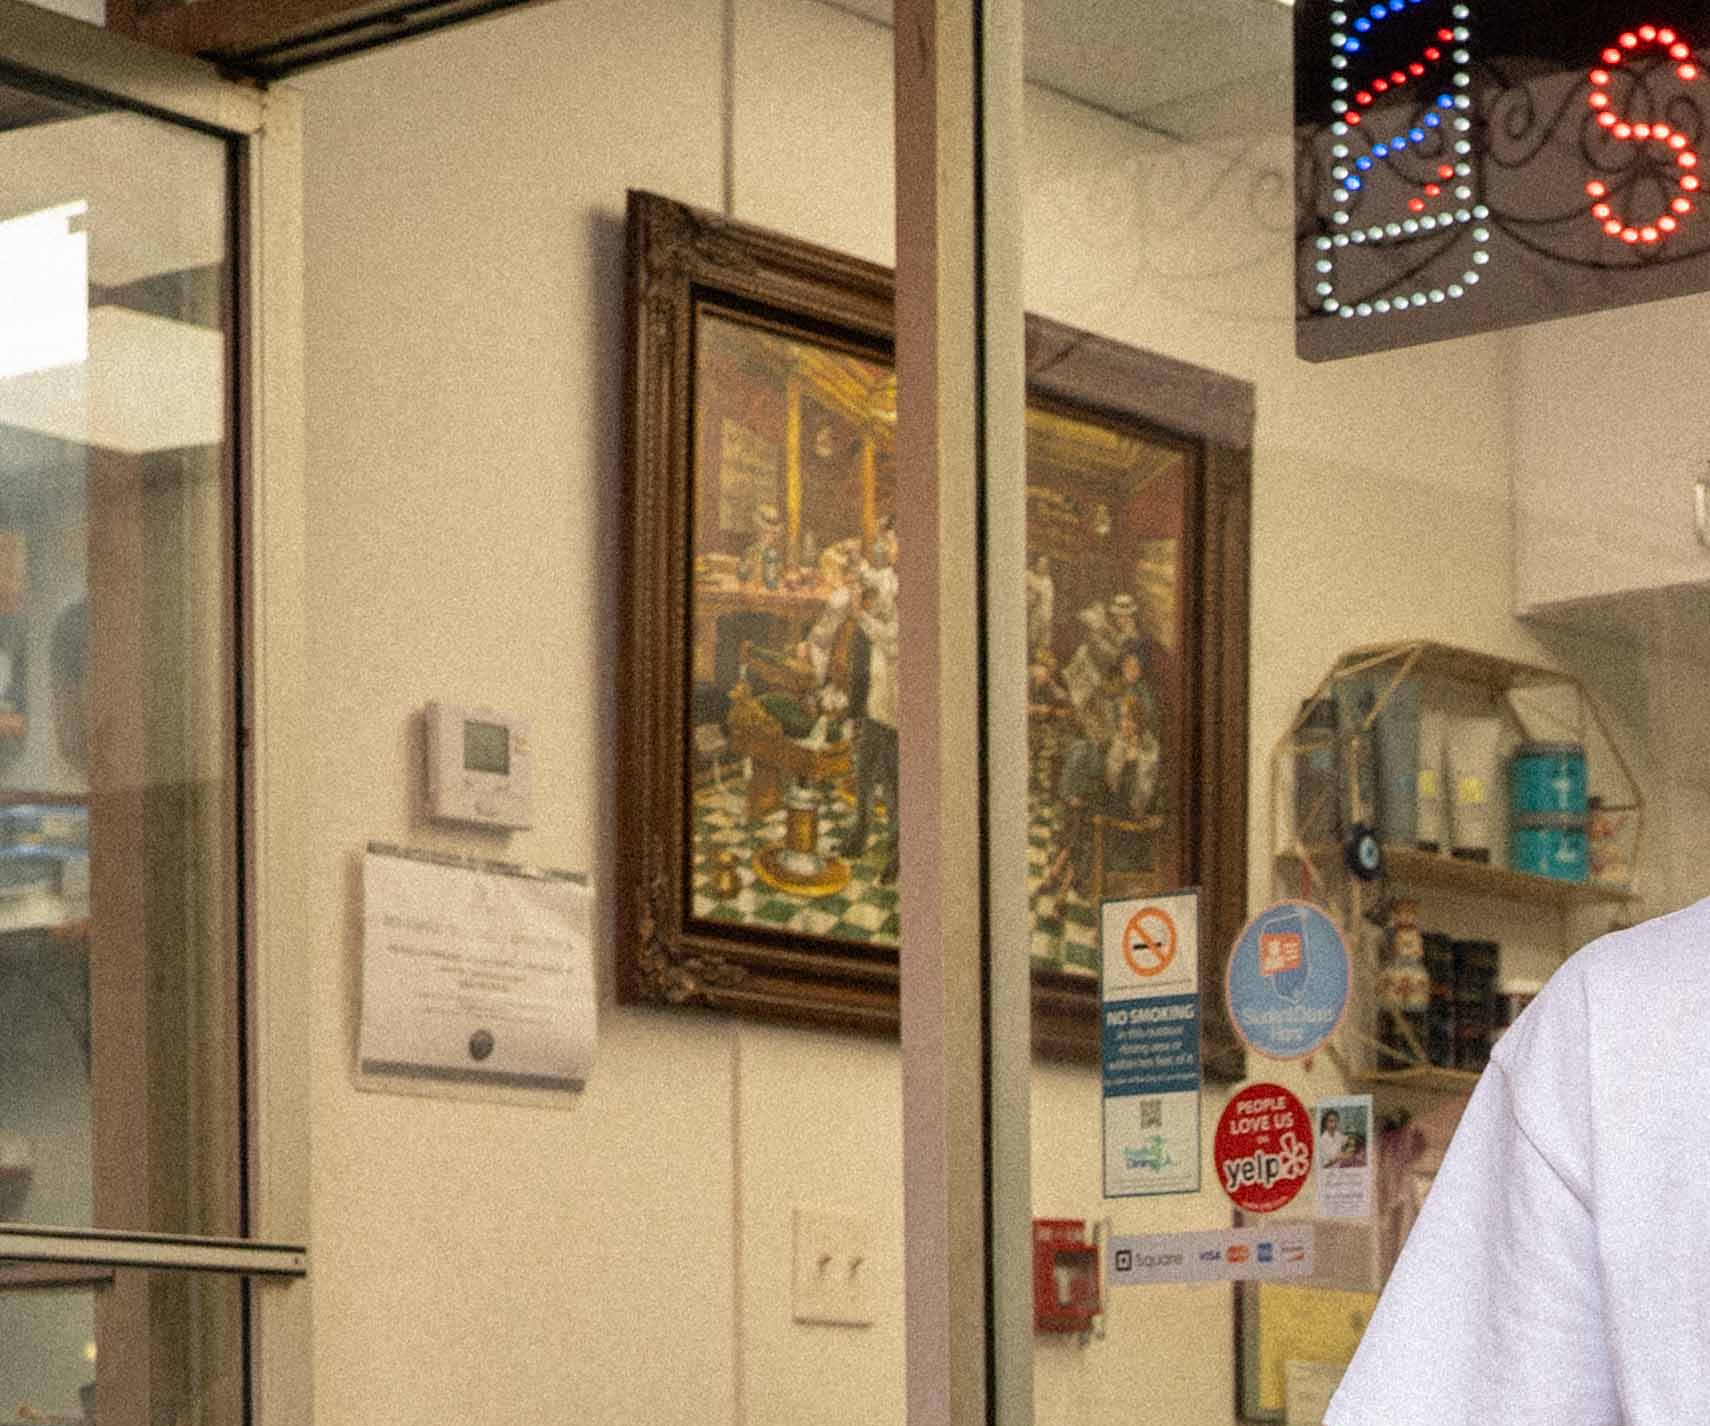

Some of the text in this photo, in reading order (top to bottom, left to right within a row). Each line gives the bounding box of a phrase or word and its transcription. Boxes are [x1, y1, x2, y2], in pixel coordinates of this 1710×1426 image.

[1106, 1004, 1196, 1026] NO SMOKING
[1236, 1096, 1287, 1114] PEOPLE
[1230, 1111, 1294, 1135] LOVE US
[1225, 1152, 1281, 1190] yelp
[1135, 1251, 1184, 1268] Square
